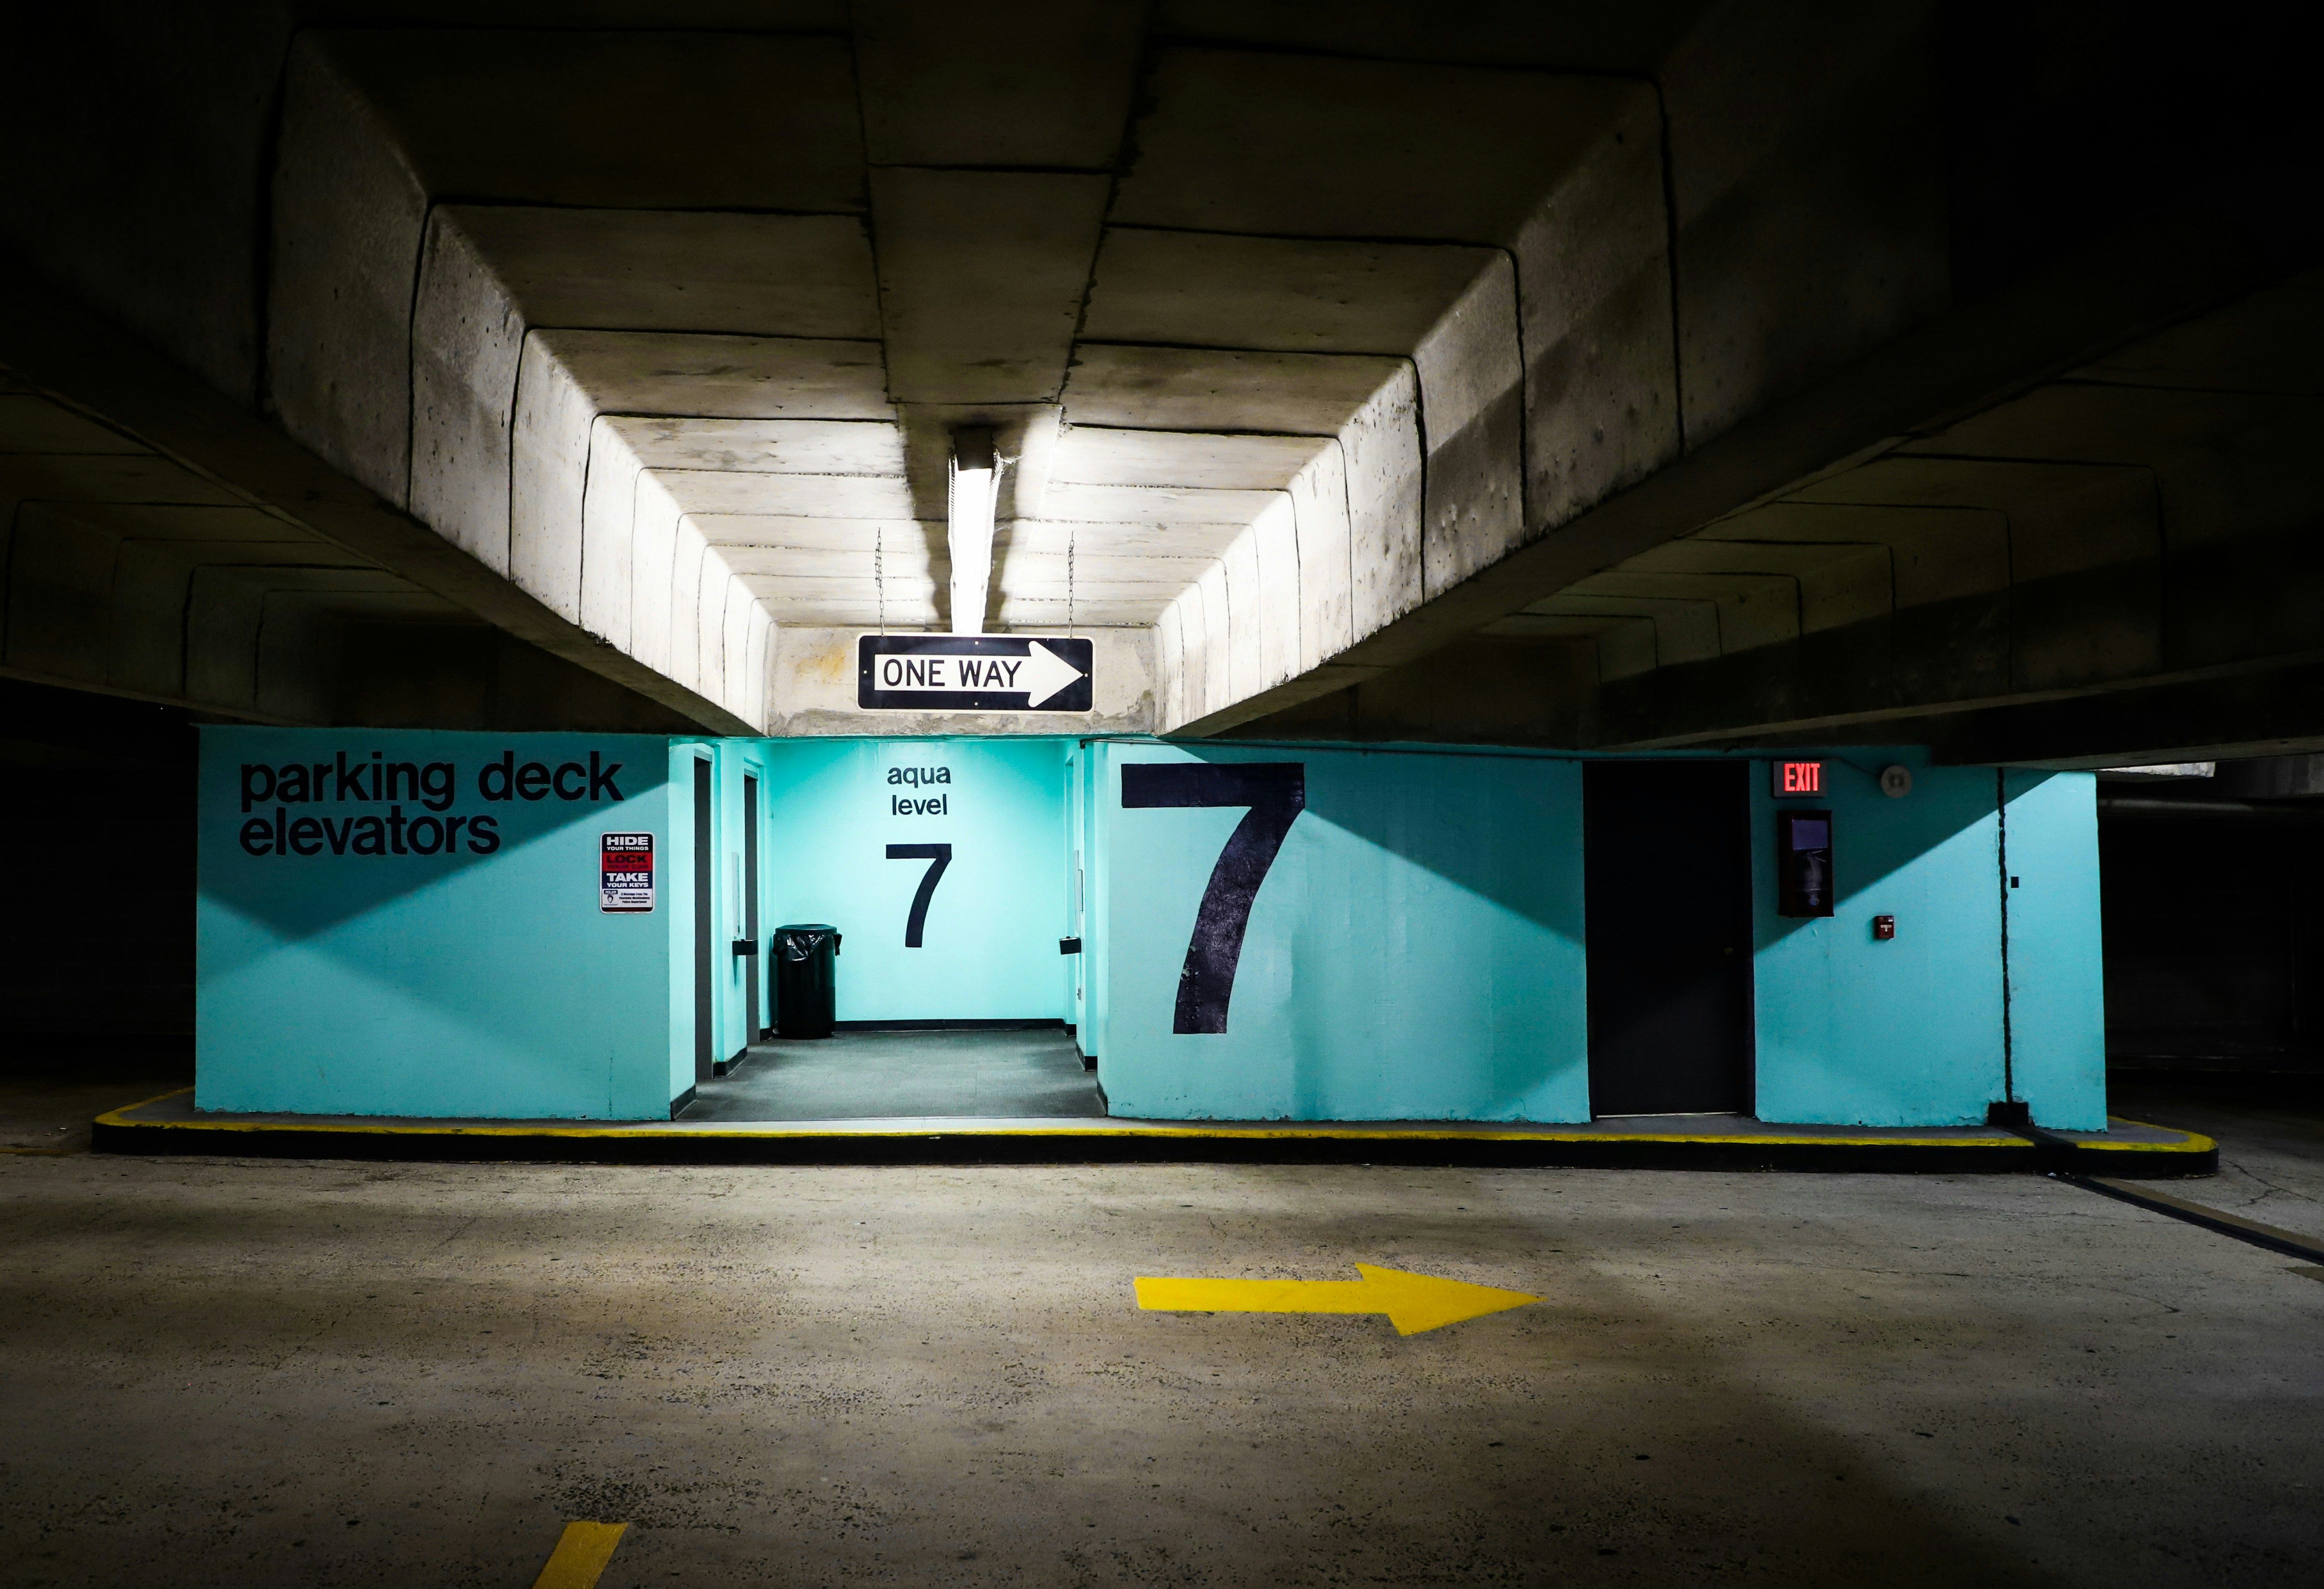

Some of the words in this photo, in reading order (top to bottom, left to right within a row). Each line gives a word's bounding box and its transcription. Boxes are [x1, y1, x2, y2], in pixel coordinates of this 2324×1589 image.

[884, 658, 945, 687] ONE
[959, 660, 1022, 687] WAY
[241, 751, 455, 813] parking
[478, 750, 625, 802] deck
[887, 766, 952, 789] aqua
[1784, 763, 1820, 791] EXIT
[892, 794, 948, 815] level
[239, 805, 501, 857] elevators
[606, 836, 648, 845] HIDE
[606, 854, 647, 863] LOCK
[606, 872, 648, 882] TAKE
[885, 844, 952, 948] 7
[1121, 762, 1305, 1034] 7
